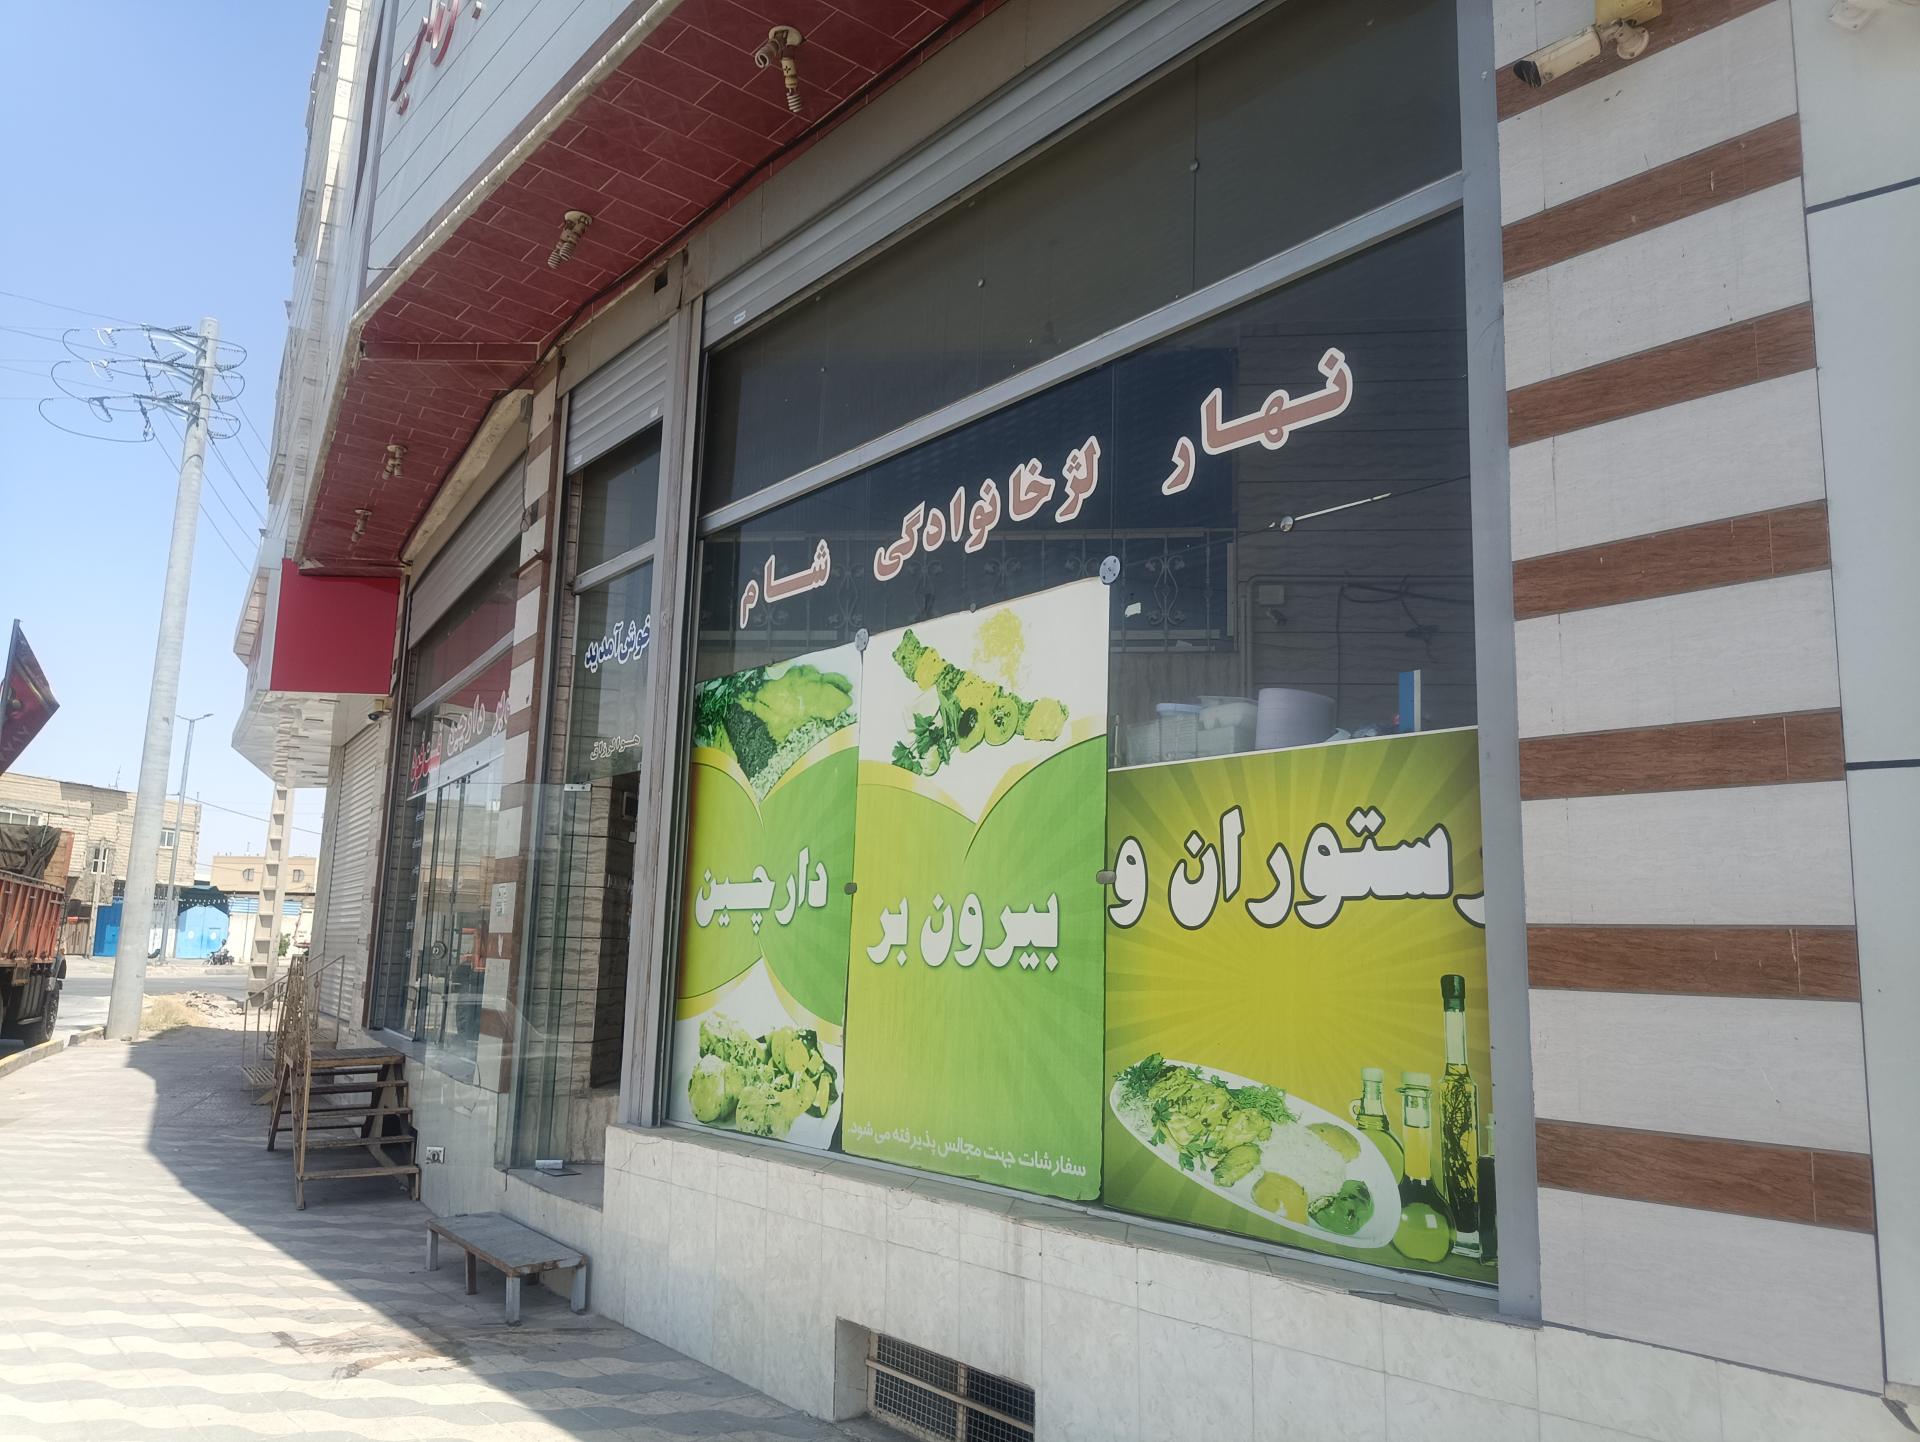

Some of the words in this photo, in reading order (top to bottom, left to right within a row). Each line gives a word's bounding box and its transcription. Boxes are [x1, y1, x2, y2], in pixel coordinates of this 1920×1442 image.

[1162, 348, 1353, 496] نهار
[740, 539, 831, 629] شام
[584, 620, 625, 674] آمدید
[617, 614, 651, 665] خوش
[694, 845, 829, 936] دارچین
[1107, 835, 1149, 930] و
[866, 896, 910, 968] بر
[919, 892, 1060, 974] بیرون
[891, 1127, 937, 1155] پذیرفته
[937, 1136, 982, 1158] مجالس
[983, 1146, 1016, 1168] جهت
[1017, 1150, 1087, 1177] سفارشات
